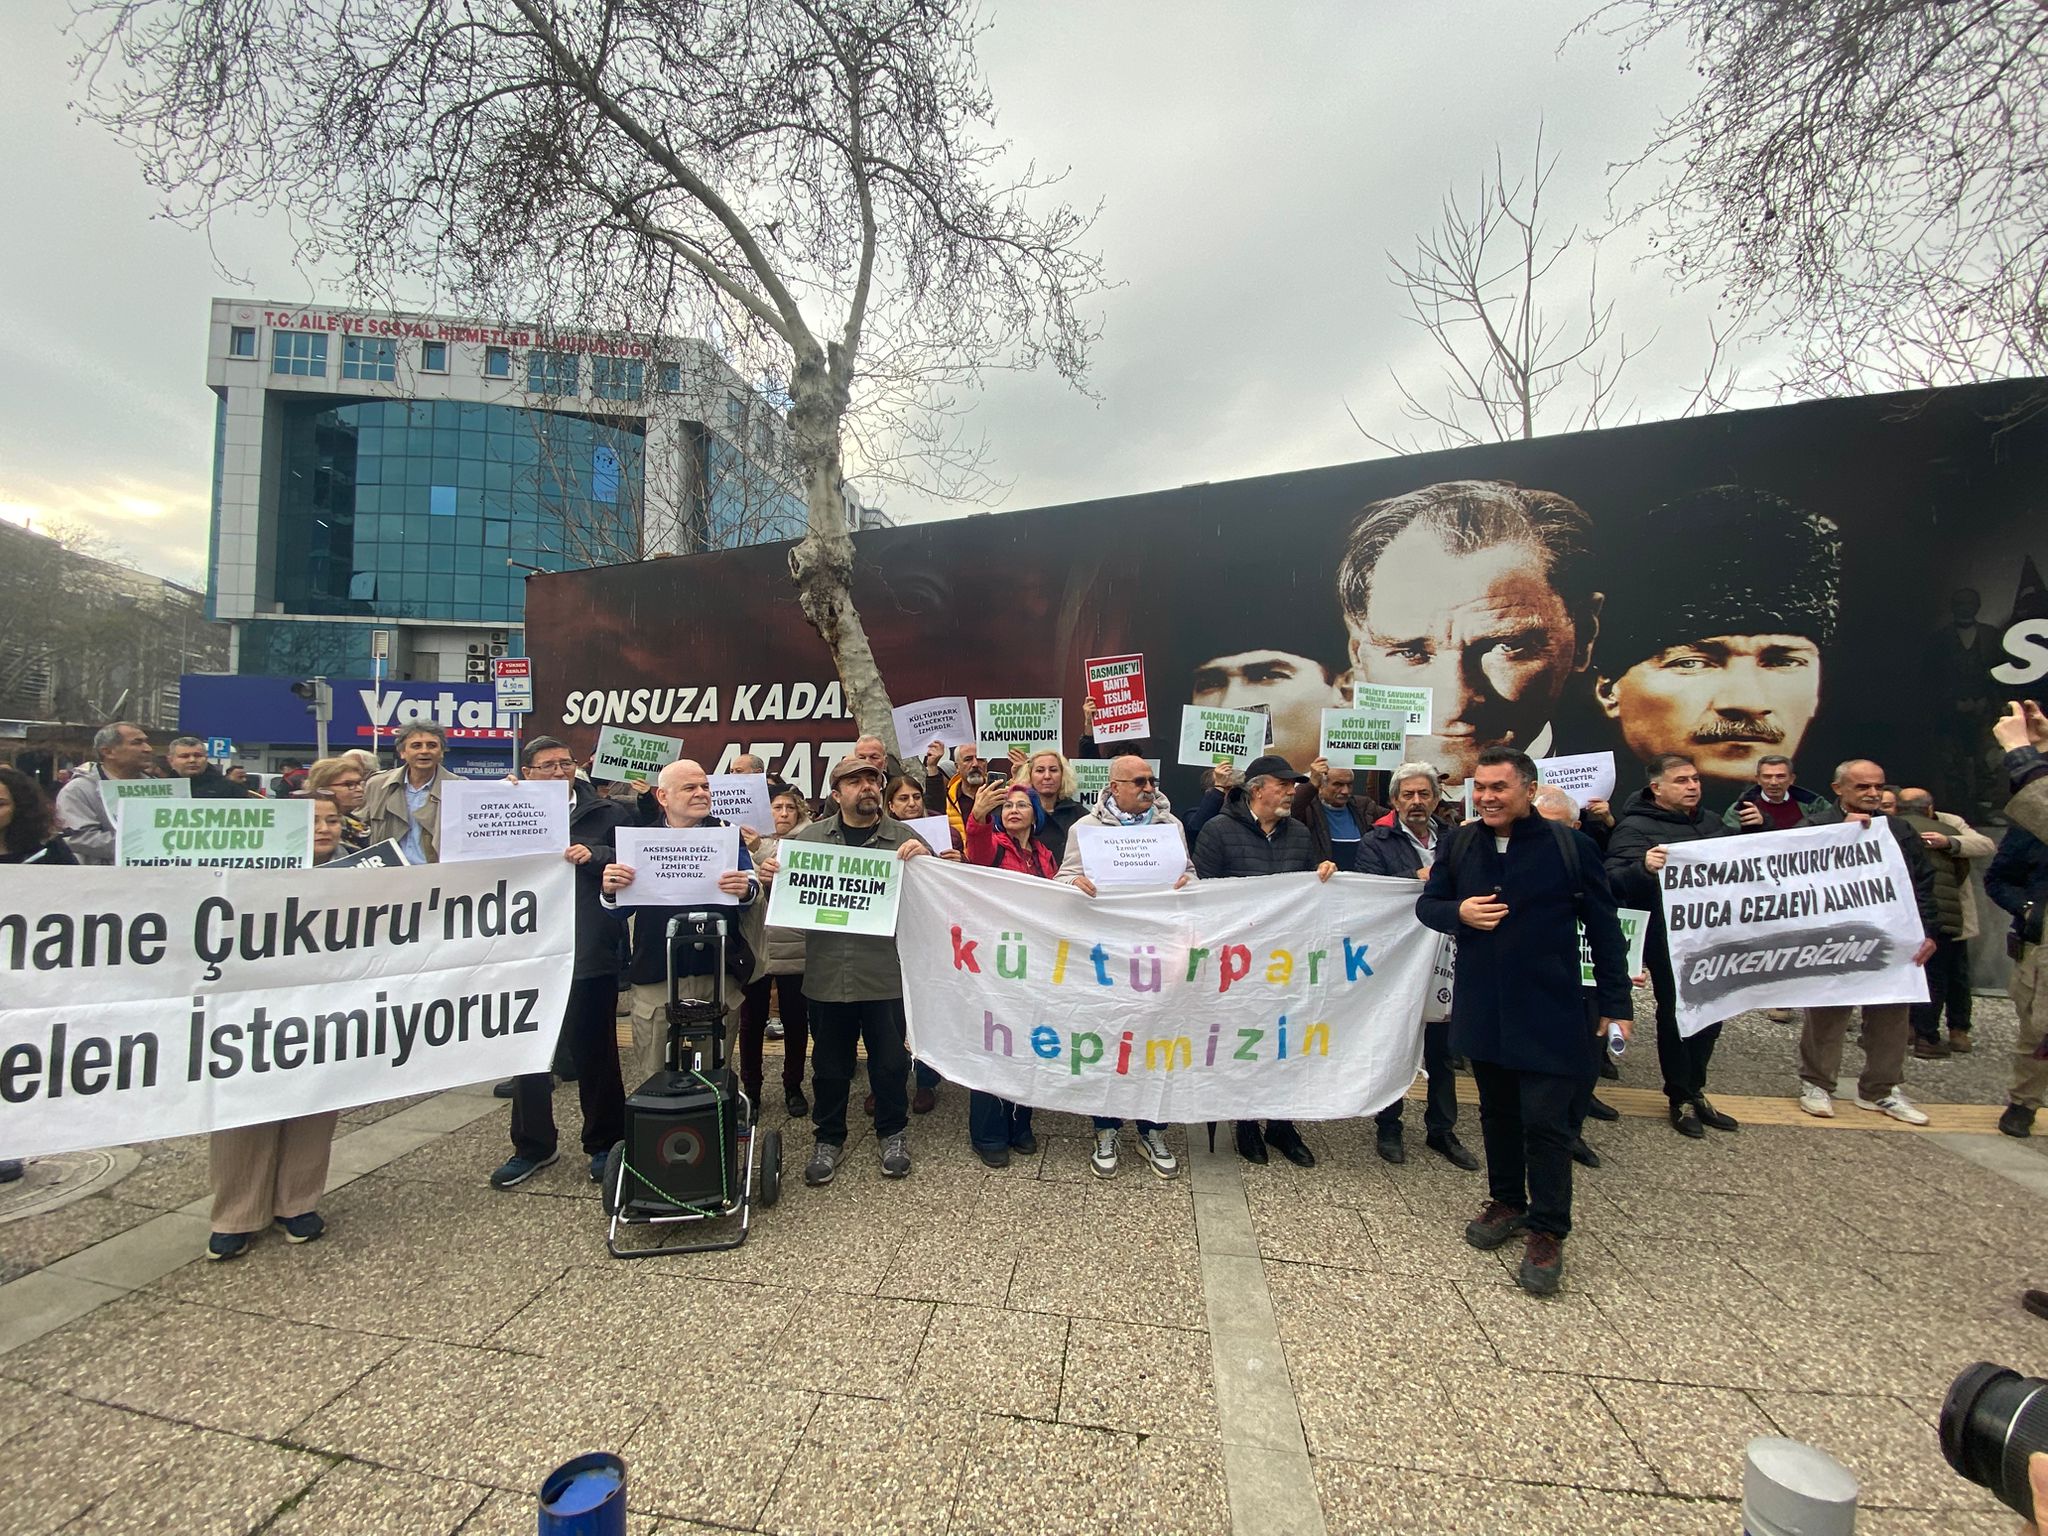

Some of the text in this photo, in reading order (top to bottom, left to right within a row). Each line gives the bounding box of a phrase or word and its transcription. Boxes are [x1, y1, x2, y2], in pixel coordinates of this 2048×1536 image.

[265, 312, 294, 328] T.C.
[300, 313, 336, 330] AİLE
[343, 318, 363, 333] VE
[368, 319, 433, 339] SOSYAL
[1091, 661, 1139, 680] BASMANE'Yİ
[1103, 677, 1129, 691] RANTA
[1103, 690, 1131, 705] TESLİM
[1359, 687, 1386, 697] BİRLİKTE
[562, 680, 854, 725] SONSUZA KADA
[989, 703, 1046, 715] BASMANE
[1094, 700, 1145, 720] ETMEYECEĞİZ
[909, 708, 958, 723] KÜLTÜRPARK
[1200, 711, 1250, 726] KAMUYA AİT
[919, 723, 953, 735] İZMİRDİR.
[995, 716, 1041, 731] ÇUKURU
[1109, 723, 1129, 733] EHP
[1206, 721, 1245, 733] OLANDAN
[1342, 717, 1391, 730] KÖTÜ NİYET
[373, 728, 515, 738] COUTER
[980, 730, 1057, 741] KAMUNUNDUR!
[1204, 729, 1246, 744] FERAGAT
[1328, 729, 1401, 741] PROTOKOLÜNDEN
[613, 733, 670, 754] SÖZ, YETKİ,
[1199, 741, 1248, 756] EDİLEMEZ!
[1327, 740, 1401, 751] İMZANIZI GERİ ÇEKİN!
[622, 747, 659, 762] KARAR
[600, 753, 666, 773] İZMİR HALKIN
[1075, 764, 1109, 774] BİRLİKTE
[117, 784, 173, 797] BASMANE
[154, 808, 275, 828] BASMANE
[468, 810, 546, 821] ŞEFFAF, ÇOĞULCU,
[467, 828, 548, 838] YÖNETİM NEREDE?
[162, 830, 265, 854] ÇUKURU
[690, 845, 717, 854] DEĞİL,
[198, 856, 302, 869] HAFIZASIDIR!
[650, 854, 711, 863] HEMŞEHRİYİZ.
[788, 851, 891, 879] KENT HAKKI
[1113, 859, 1160, 868] Deposudur.
[1664, 839, 1883, 890] BASMANE ÇUKURU'NDAN
[655, 872, 706, 880] YAŞIYORUZ.
[789, 872, 886, 895] RANTA TESLİM
[799, 890, 871, 911] EDİLEMEZ!
[1670, 876, 1897, 931] BUCA CEZAEVİ ALANINA
[194, 879, 539, 981] Çukuru'nda
[950, 924, 1374, 993] kültürpark
[1689, 935, 1880, 985] BU KENT BİZİM!
[187, 988, 540, 1082] İstemiyoruz
[983, 1010, 1331, 1076] hepimizin
